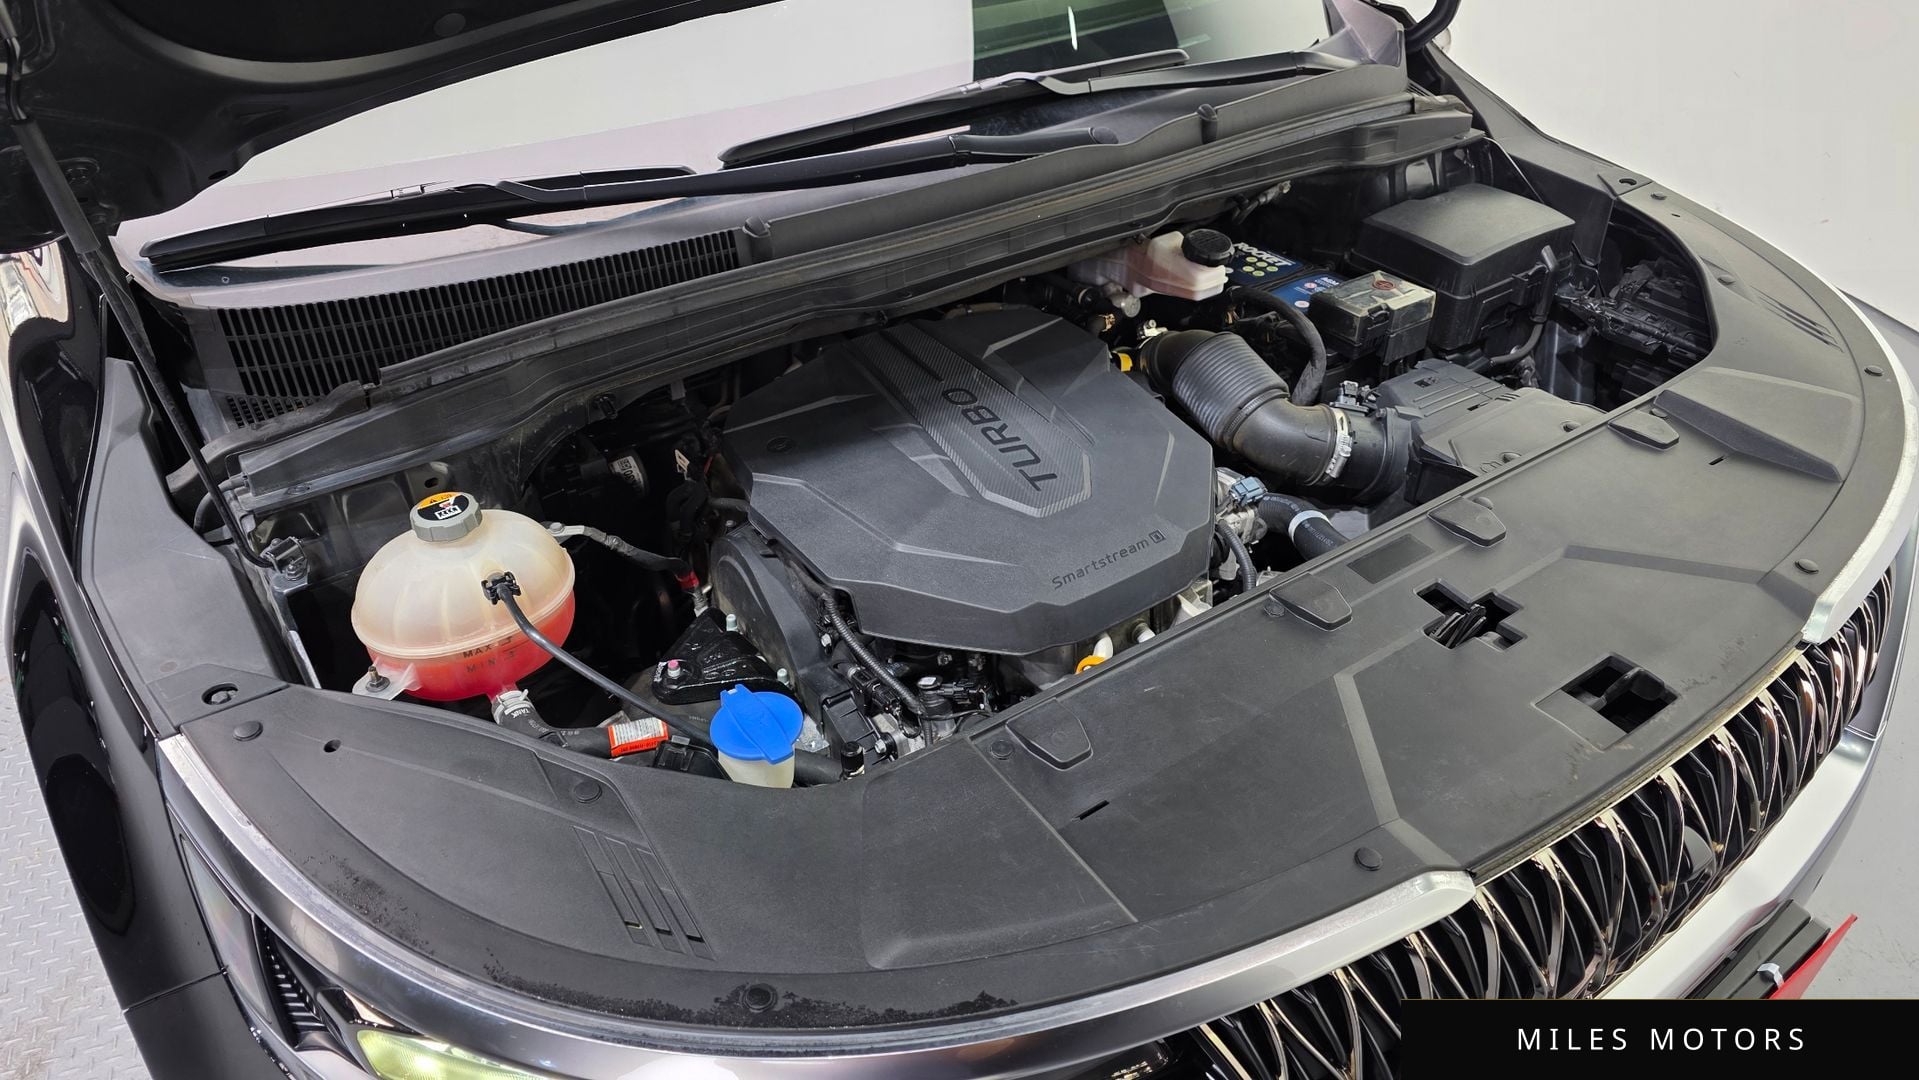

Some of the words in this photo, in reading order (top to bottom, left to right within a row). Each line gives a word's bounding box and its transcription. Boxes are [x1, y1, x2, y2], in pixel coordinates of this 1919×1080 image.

[1233, 242, 1292, 266] ROCKET
[942, 388, 1058, 491] TURBO
[1052, 539, 1149, 590] Smartstream
[463, 644, 492, 658] MAX
[467, 657, 496, 672] MIN
